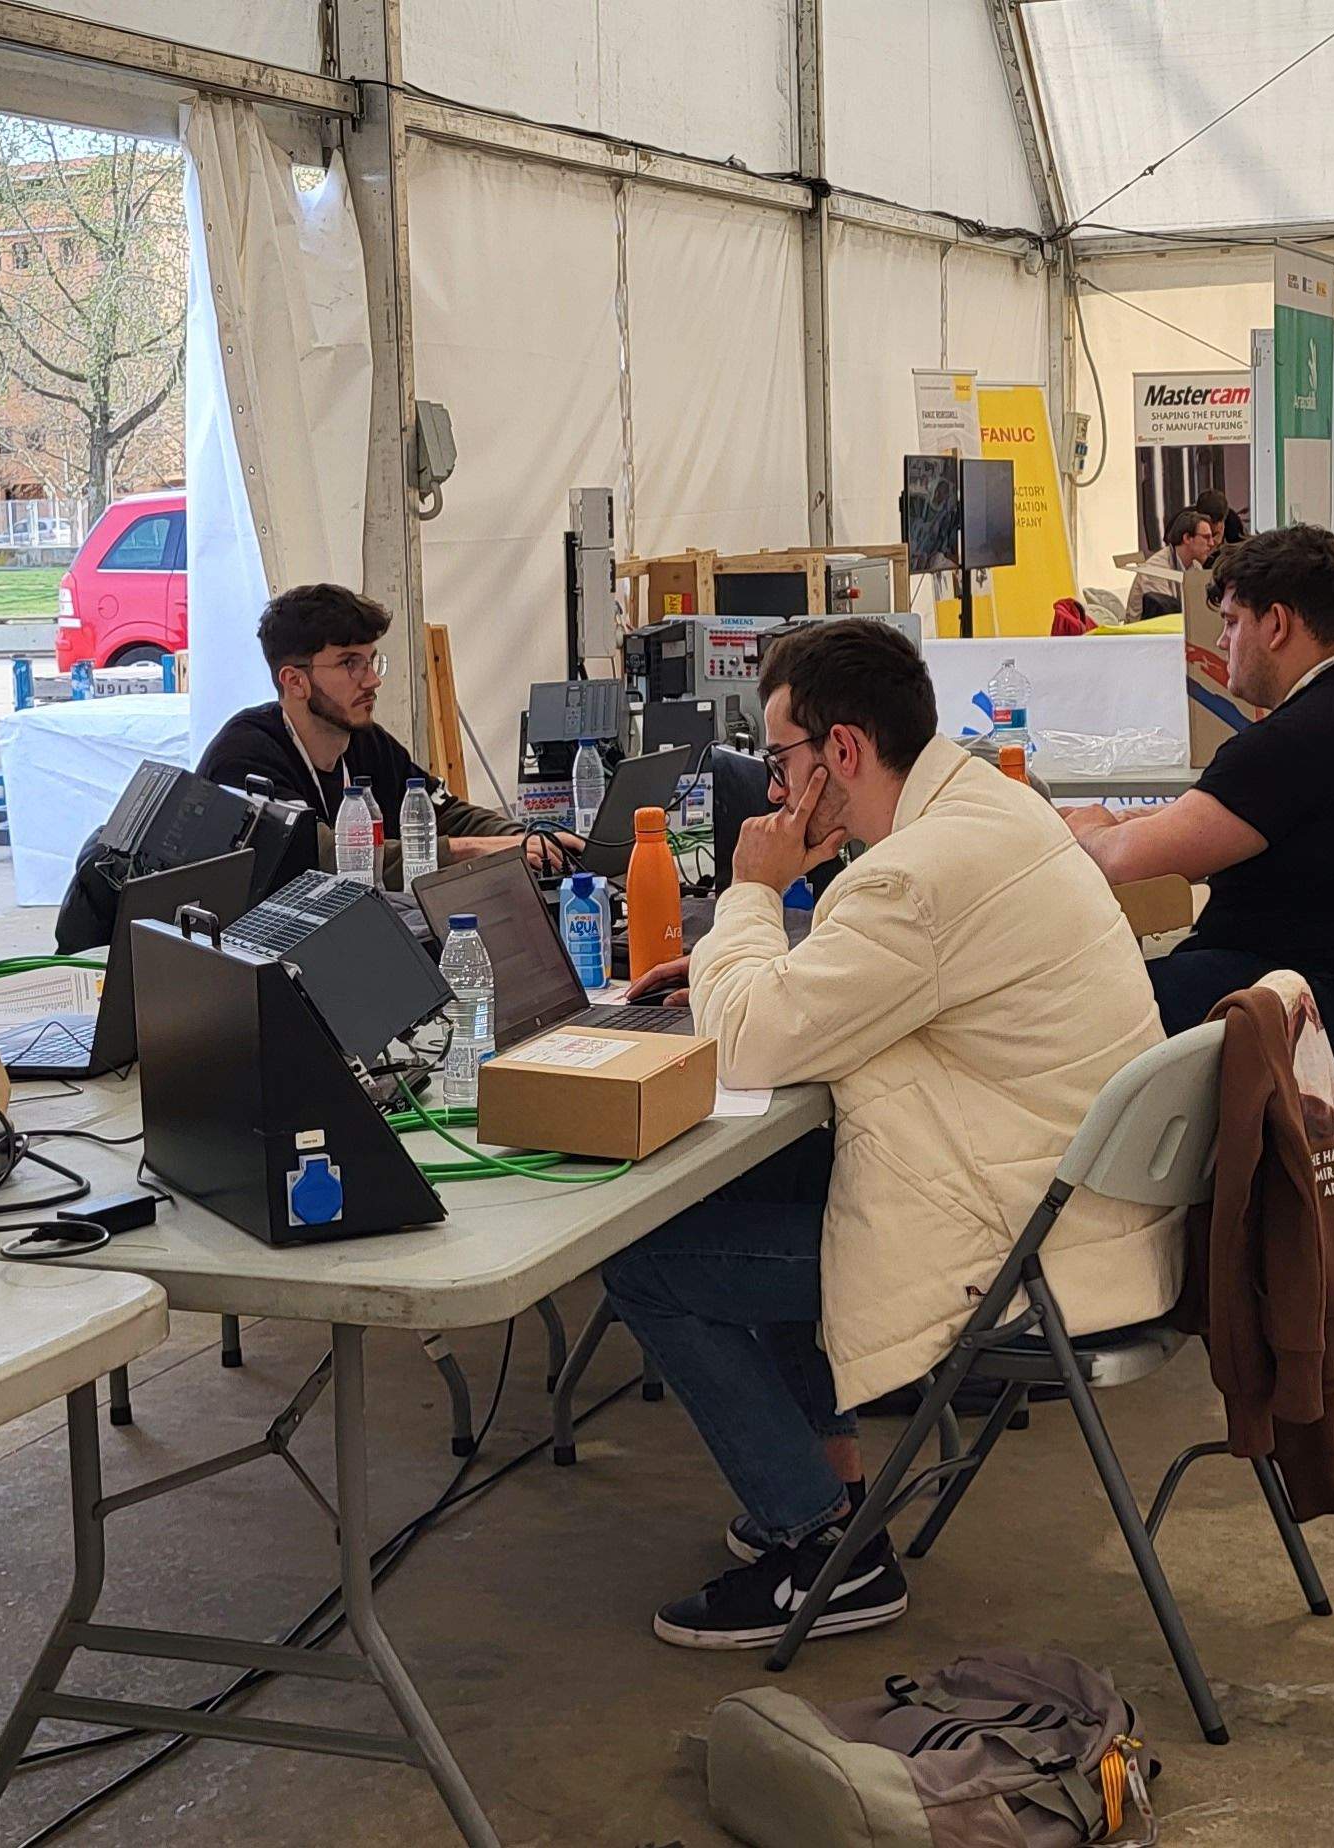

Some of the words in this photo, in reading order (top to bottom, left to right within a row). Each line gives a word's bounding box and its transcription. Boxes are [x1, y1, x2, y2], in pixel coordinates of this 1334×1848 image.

[1143, 384, 1251, 407] Mastercam
[1151, 411, 1190, 421] SHAPING
[1192, 410, 1208, 419] THE
[1210, 410, 1243, 419] FUTURE
[1152, 423, 1164, 432] OF
[1166, 421, 1243, 432] MANUFACTURING
[980, 427, 1036, 443] FANUC
[720, 618, 754, 626] SIEMENS
